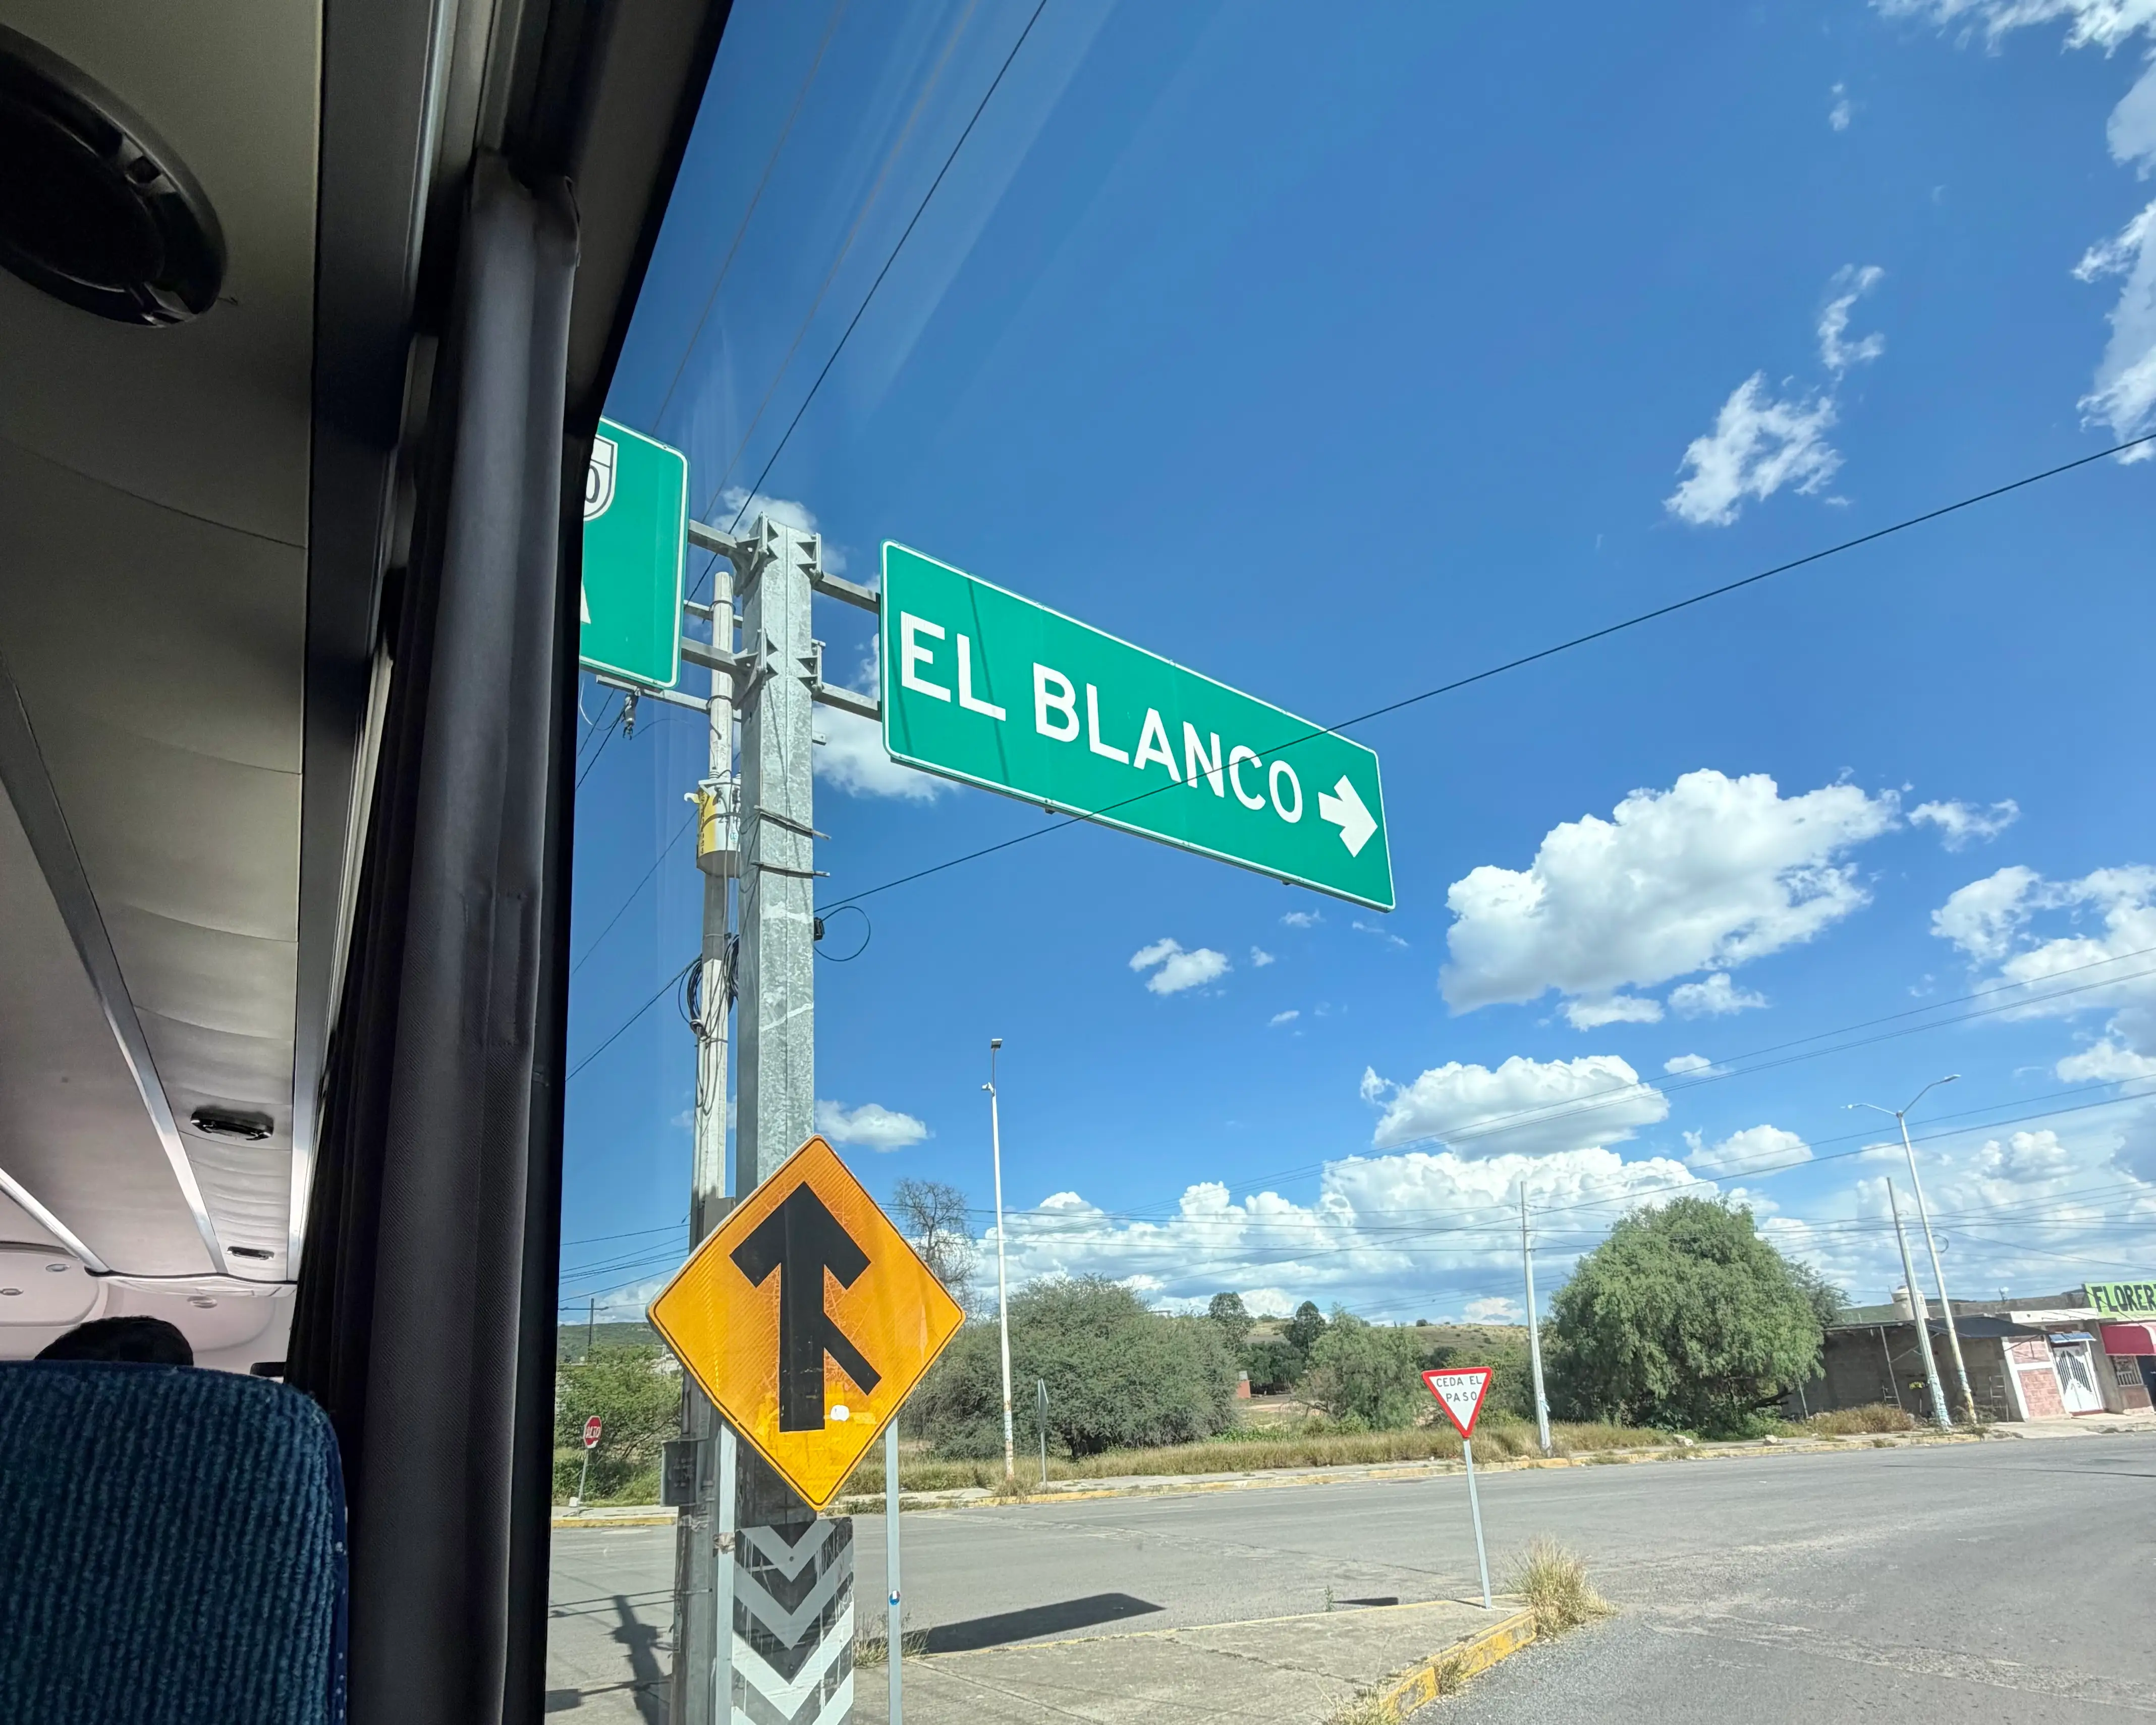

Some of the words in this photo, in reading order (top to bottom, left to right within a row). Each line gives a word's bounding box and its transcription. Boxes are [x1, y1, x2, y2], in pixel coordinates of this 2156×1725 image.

[901, 611, 1006, 722] EL
[1033, 662, 1303, 823] BLANCO
[2090, 1284, 2156, 1312] FLORER
[1436, 1376, 1464, 1387] CEDA
[1469, 1376, 1482, 1384] EL
[1446, 1391, 1477, 1402] PASO
[585, 1426, 600, 1438] ALTO
